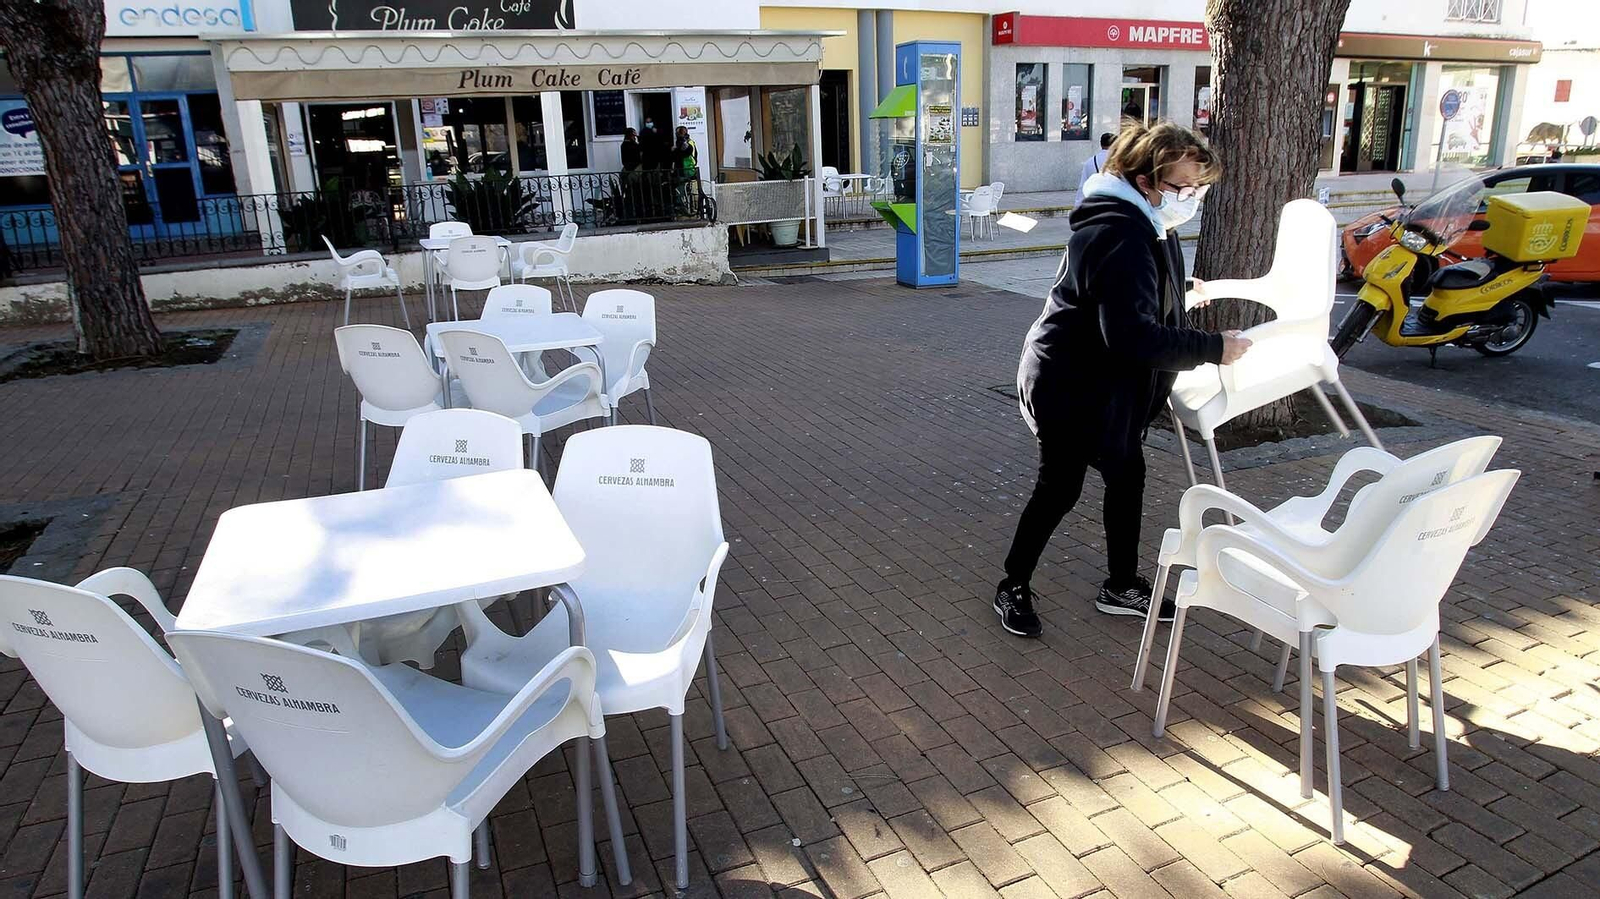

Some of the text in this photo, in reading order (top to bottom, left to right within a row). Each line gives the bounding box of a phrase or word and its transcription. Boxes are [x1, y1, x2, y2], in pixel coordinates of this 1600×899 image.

[119, 5, 240, 27] endesa
[500, 0, 531, 16] Café
[370, 6, 505, 31] Plum Cake
[1129, 26, 1203, 44] MAPFRE
[458, 68, 642, 88] Plum Cake Café
[430, 454, 490, 466] CERVEZAS ALHAMBRA
[598, 476, 675, 488] CERVEZAS ALHAMBRA
[1418, 527, 1448, 540] CERVEZAS
[12, 622, 98, 644] CERVEZAS ALHAMBRA
[236, 686, 340, 714] CERVEZAS ALHAMBRA
